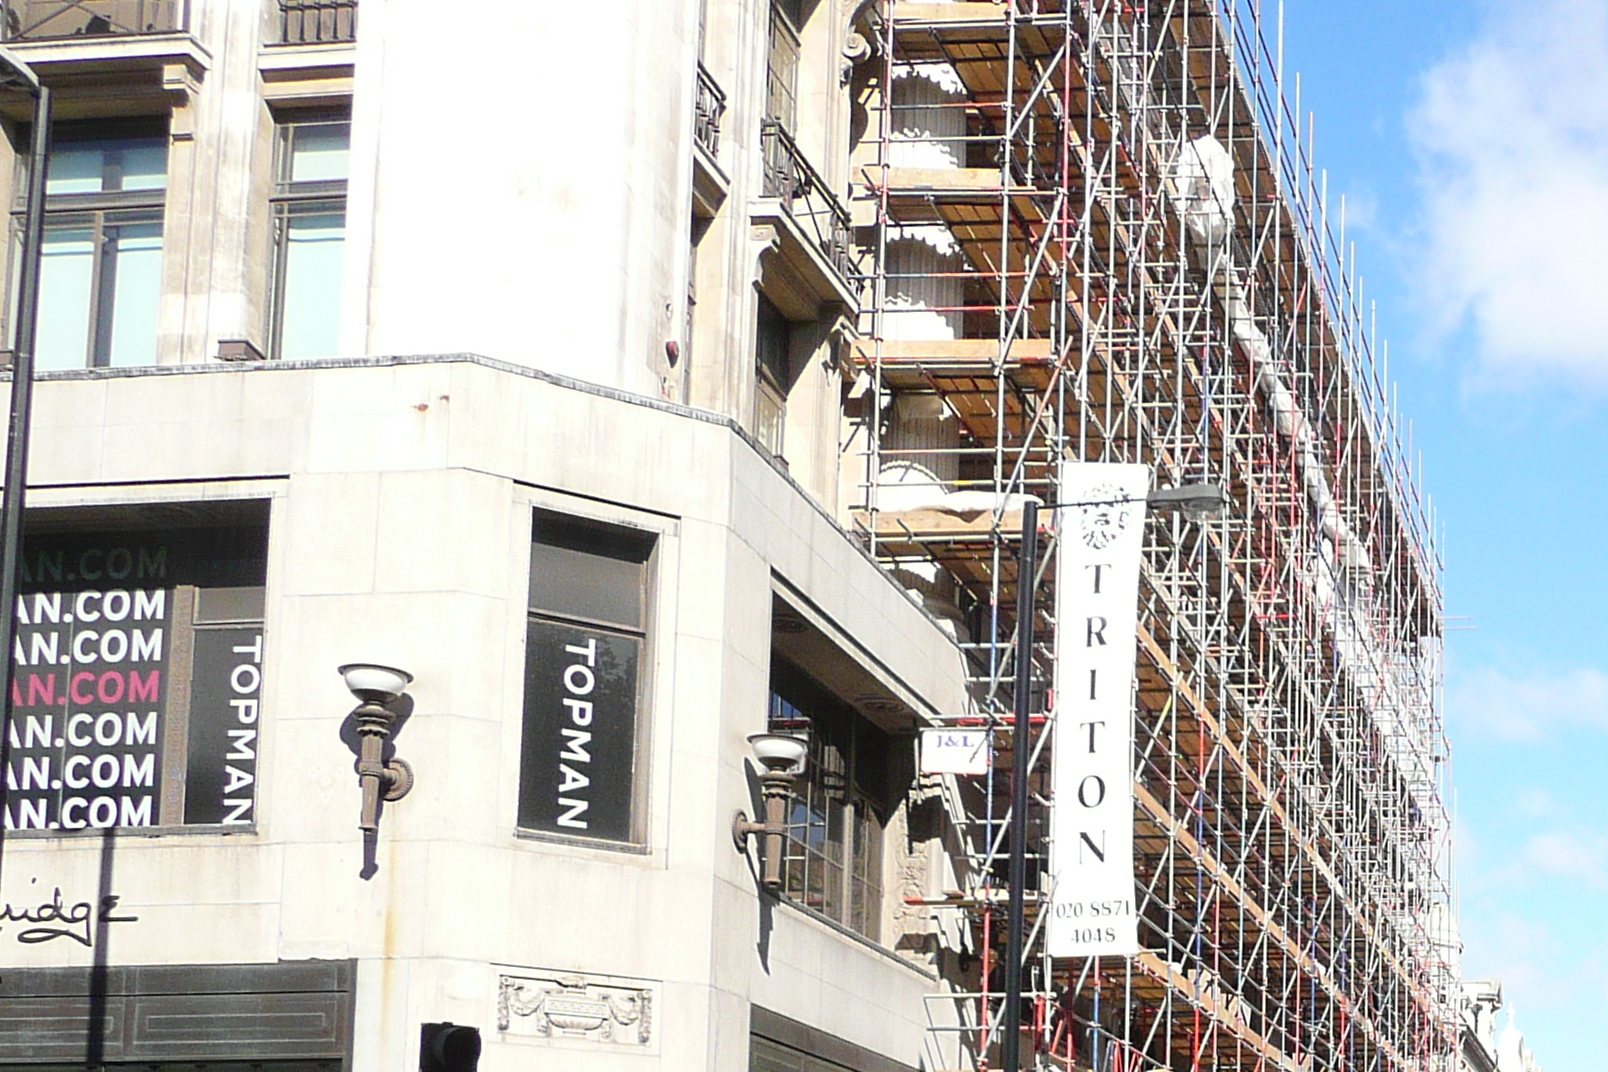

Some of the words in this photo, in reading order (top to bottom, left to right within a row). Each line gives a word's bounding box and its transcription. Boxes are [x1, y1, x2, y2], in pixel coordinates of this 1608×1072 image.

[222, 635, 262, 825] TOPMAN
[557, 638, 596, 829] TOPMAN
[937, 735, 975, 748] J&L
[1078, 563, 1112, 865] TRITON
[1056, 903, 1083, 919] 020
[1089, 900, 1130, 917] 8871
[1071, 928, 1116, 943] 4048
